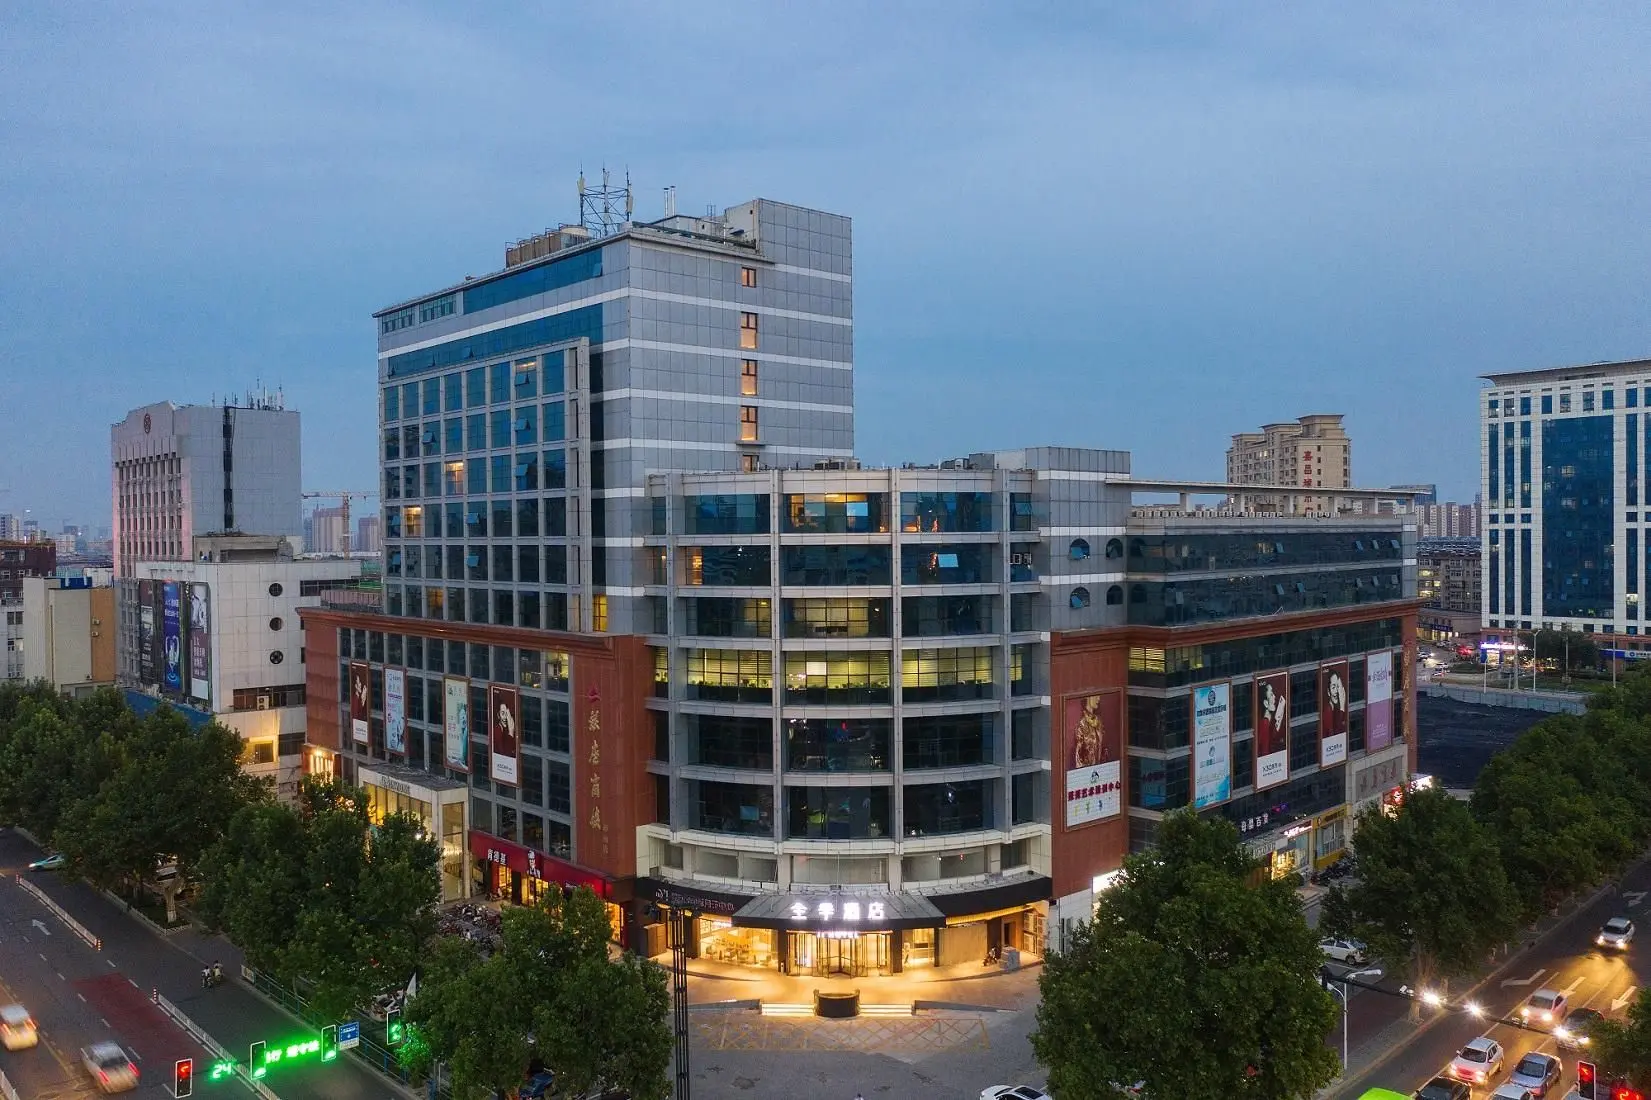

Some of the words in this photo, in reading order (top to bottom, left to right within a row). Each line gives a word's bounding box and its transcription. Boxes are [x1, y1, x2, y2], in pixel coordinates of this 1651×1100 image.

[487, 848, 507, 866] 肯德基
[790, 902, 885, 921] 全季酒店
[212, 1063, 233, 1079] 24
